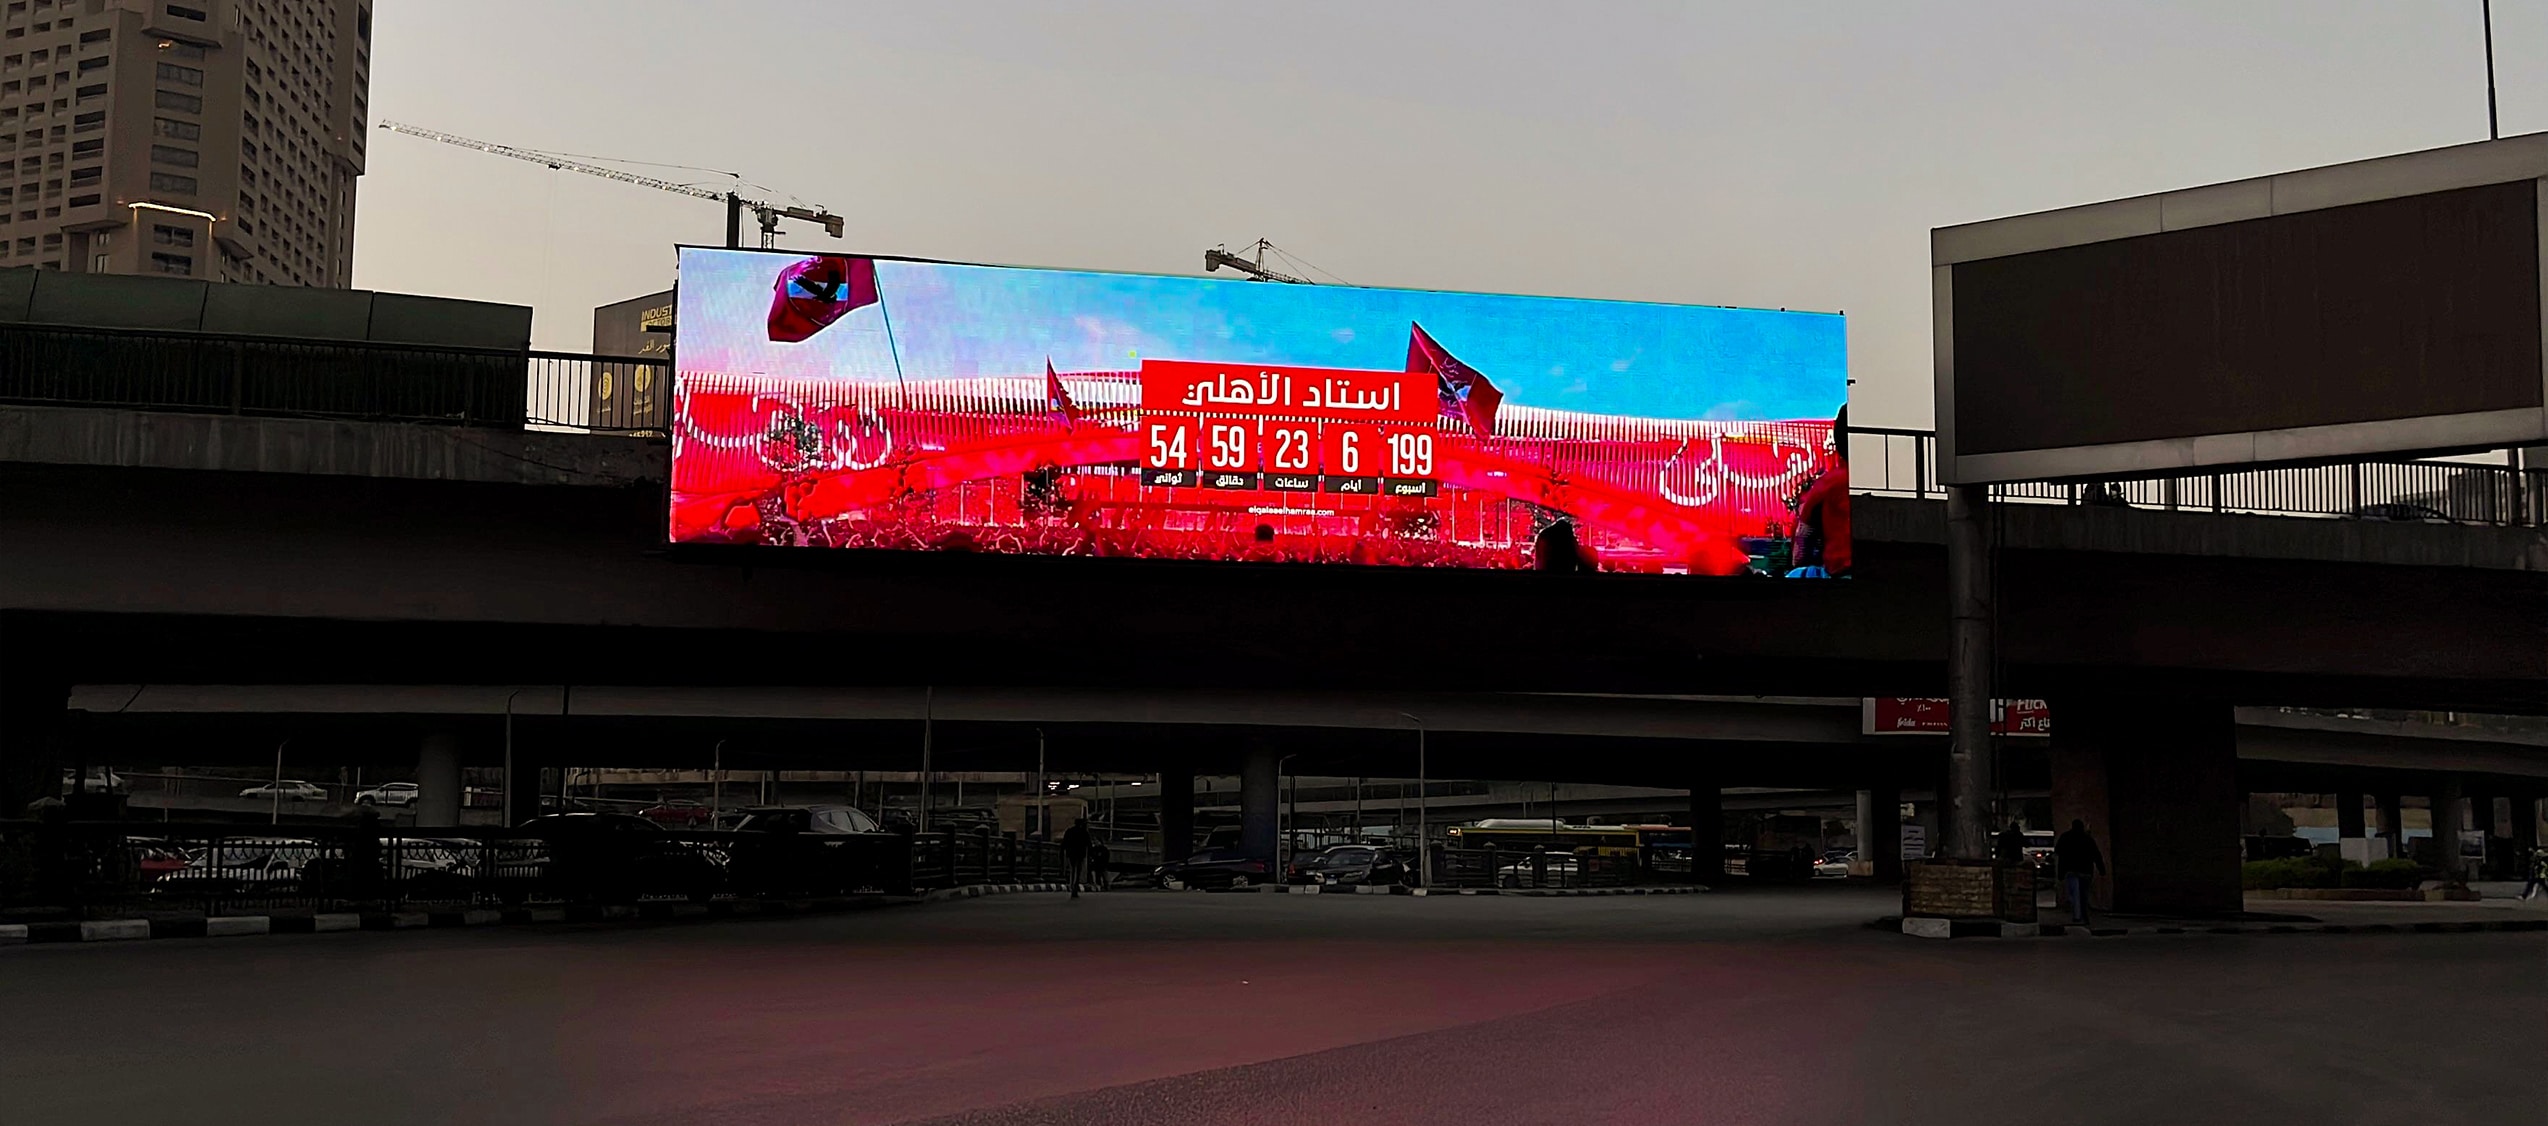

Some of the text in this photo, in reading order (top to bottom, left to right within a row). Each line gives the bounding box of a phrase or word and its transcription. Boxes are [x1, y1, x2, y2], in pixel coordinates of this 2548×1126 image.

[1182, 371, 1400, 411] استاد الأهلي
[1150, 424, 1433, 476] 54 59 23 6 199
[1274, 477, 1309, 489] ساعات
